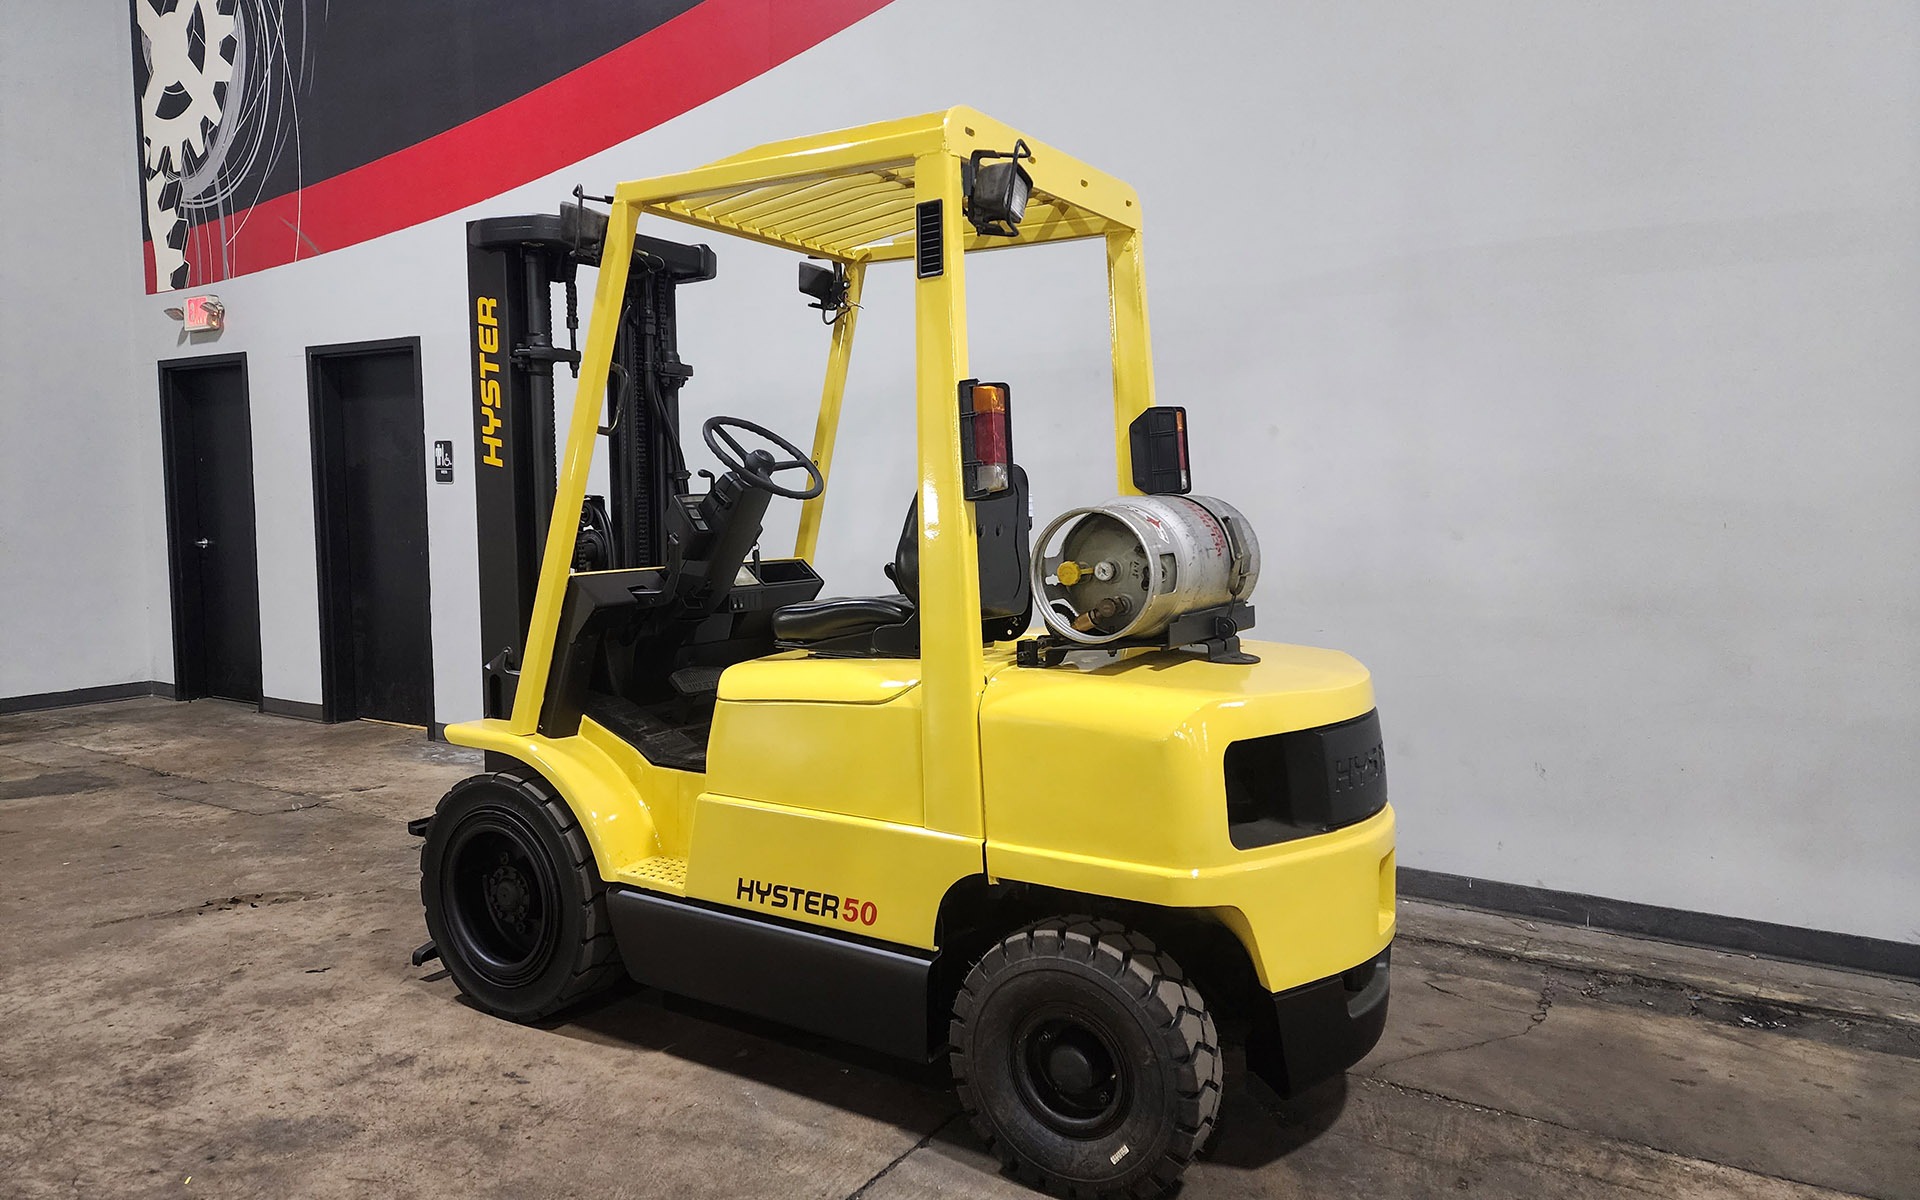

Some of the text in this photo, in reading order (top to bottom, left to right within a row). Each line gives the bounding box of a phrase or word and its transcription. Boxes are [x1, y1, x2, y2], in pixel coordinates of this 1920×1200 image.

[477, 296, 503, 467] HYSTER
[736, 877, 878, 926] HYSTER 50
